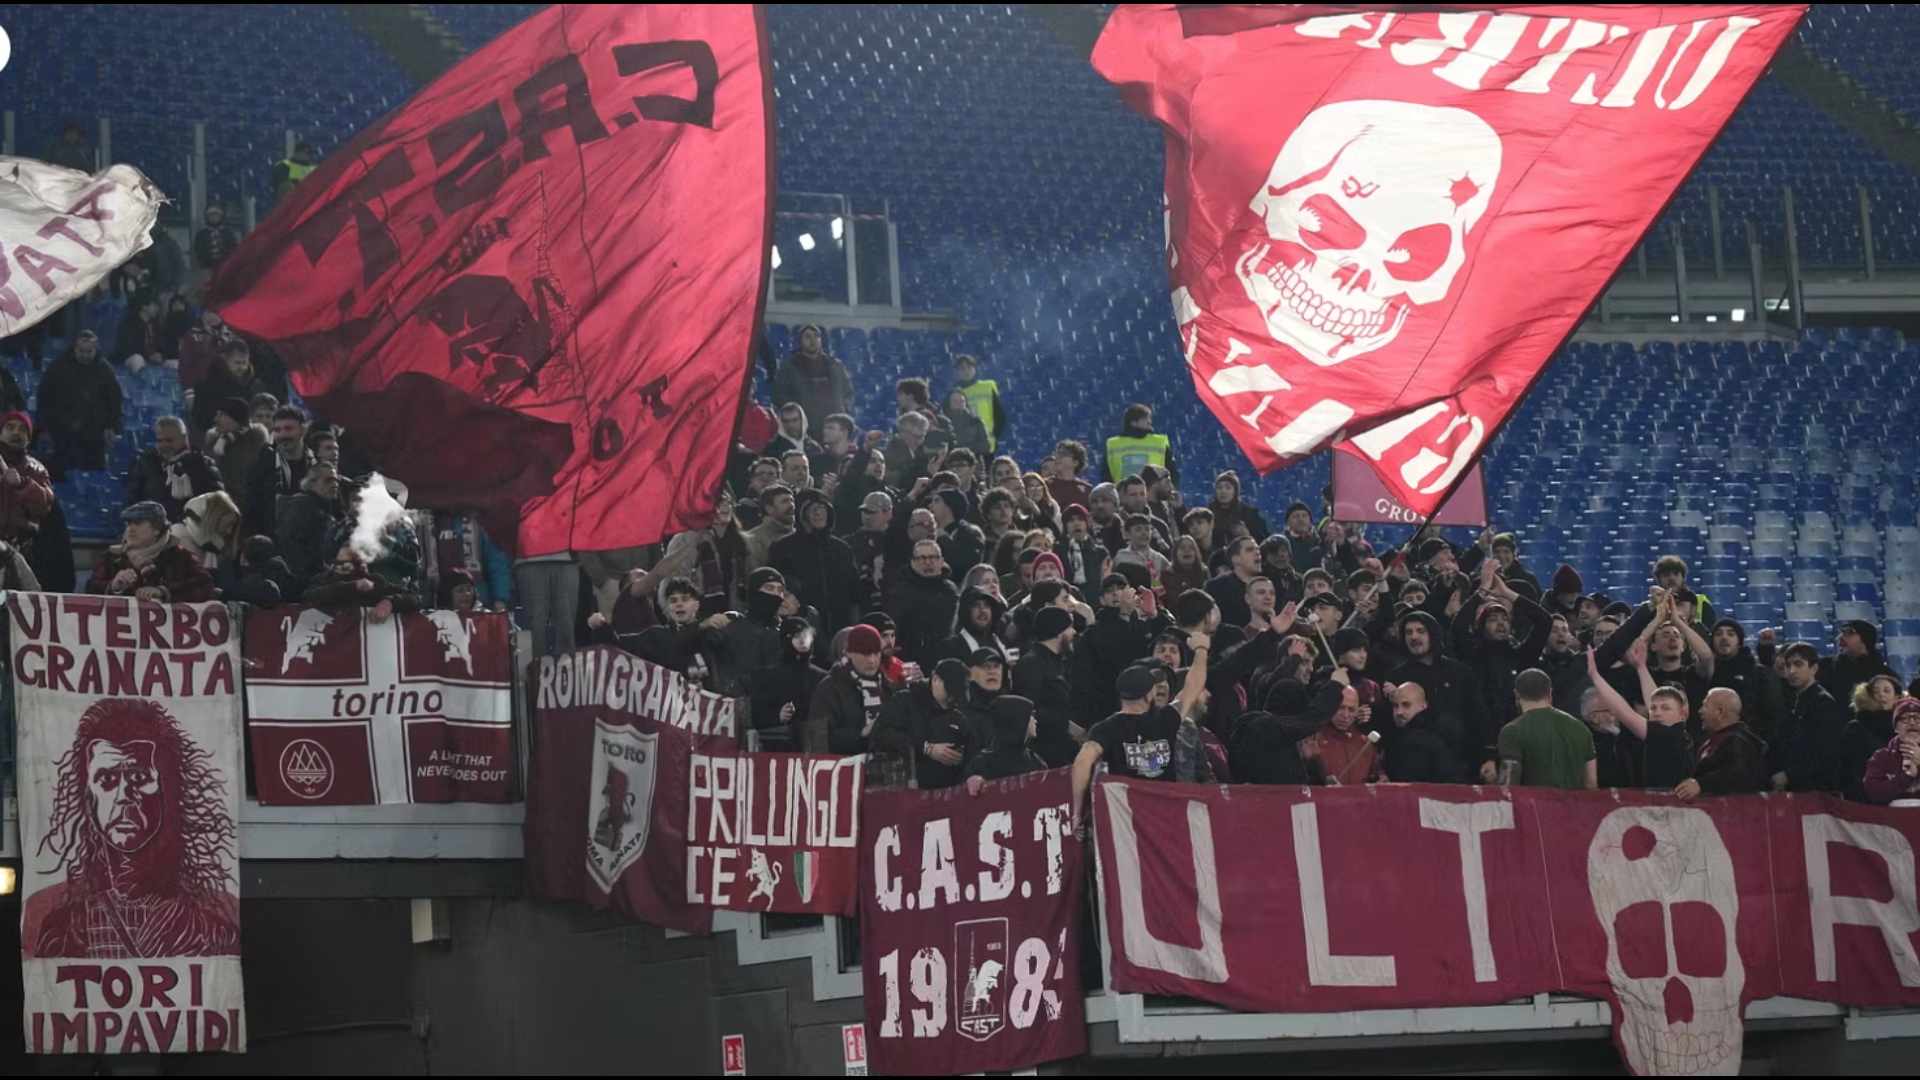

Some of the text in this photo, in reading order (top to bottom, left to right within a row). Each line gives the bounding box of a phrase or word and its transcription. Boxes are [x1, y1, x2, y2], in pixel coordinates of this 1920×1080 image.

[1375, 498, 1441, 523] GRO
[9, 594, 230, 650] VITERBO
[14, 644, 235, 696] GRANATA
[332, 684, 443, 717] torino
[429, 750, 438, 761] A
[464, 754, 492, 766] THAT
[602, 737, 646, 764] TORO
[452, 769, 478, 781] OES
[481, 770, 507, 781] OUT
[586, 836, 604, 867] OMA
[56, 964, 203, 1009] TORI
[32, 1009, 241, 1054] IMPAVIDI
